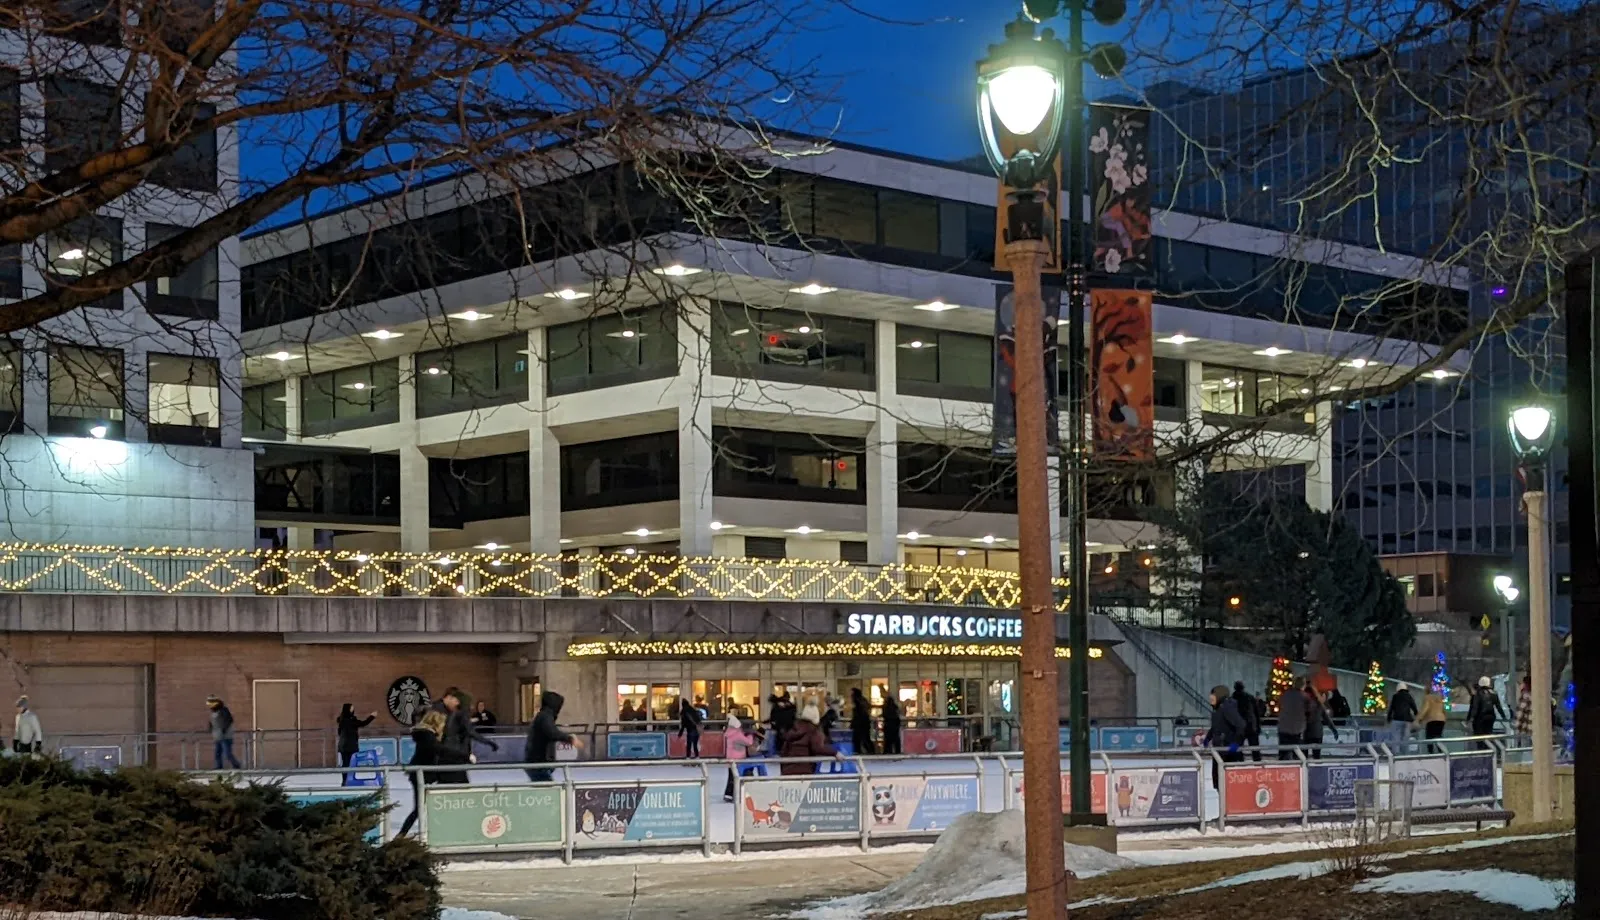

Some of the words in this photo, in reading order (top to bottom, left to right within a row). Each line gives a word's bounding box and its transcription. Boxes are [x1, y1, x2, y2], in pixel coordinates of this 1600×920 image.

[847, 613, 962, 637] STARBUCKS
[965, 616, 1022, 638] COFFEE
[608, 791, 637, 810] APPLY
[643, 791, 685, 809] ONLINE.
[807, 787, 845, 804] ONLINE.
